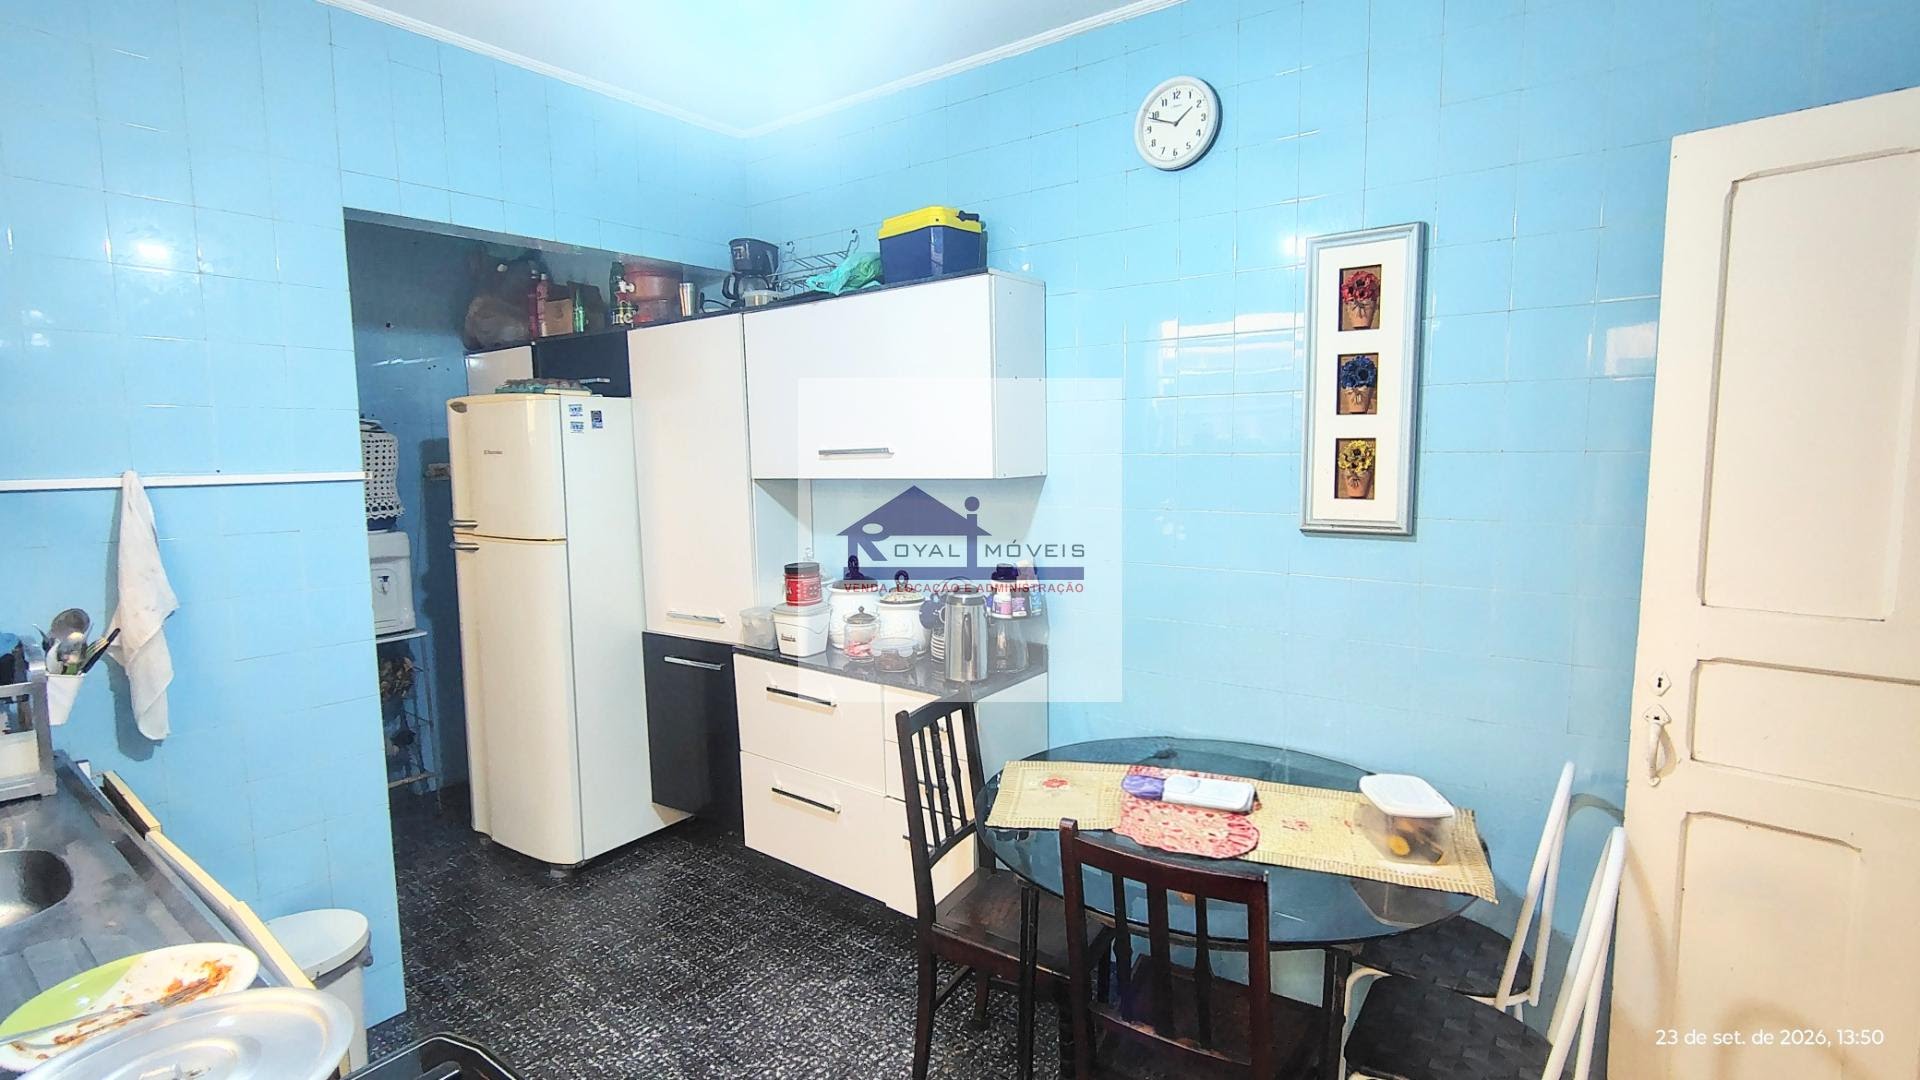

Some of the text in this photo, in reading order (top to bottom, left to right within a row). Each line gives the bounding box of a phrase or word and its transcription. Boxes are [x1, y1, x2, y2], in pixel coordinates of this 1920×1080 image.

[1173, 91, 1181, 99] 12
[1161, 99, 1168, 107] 11
[1196, 100, 1202, 108] 2
[1151, 111, 1159, 119] 10
[1200, 113, 1206, 121] 3
[1151, 139, 1156, 147] 8
[1186, 141, 1191, 149] 5
[1173, 148, 1178, 156] 6
